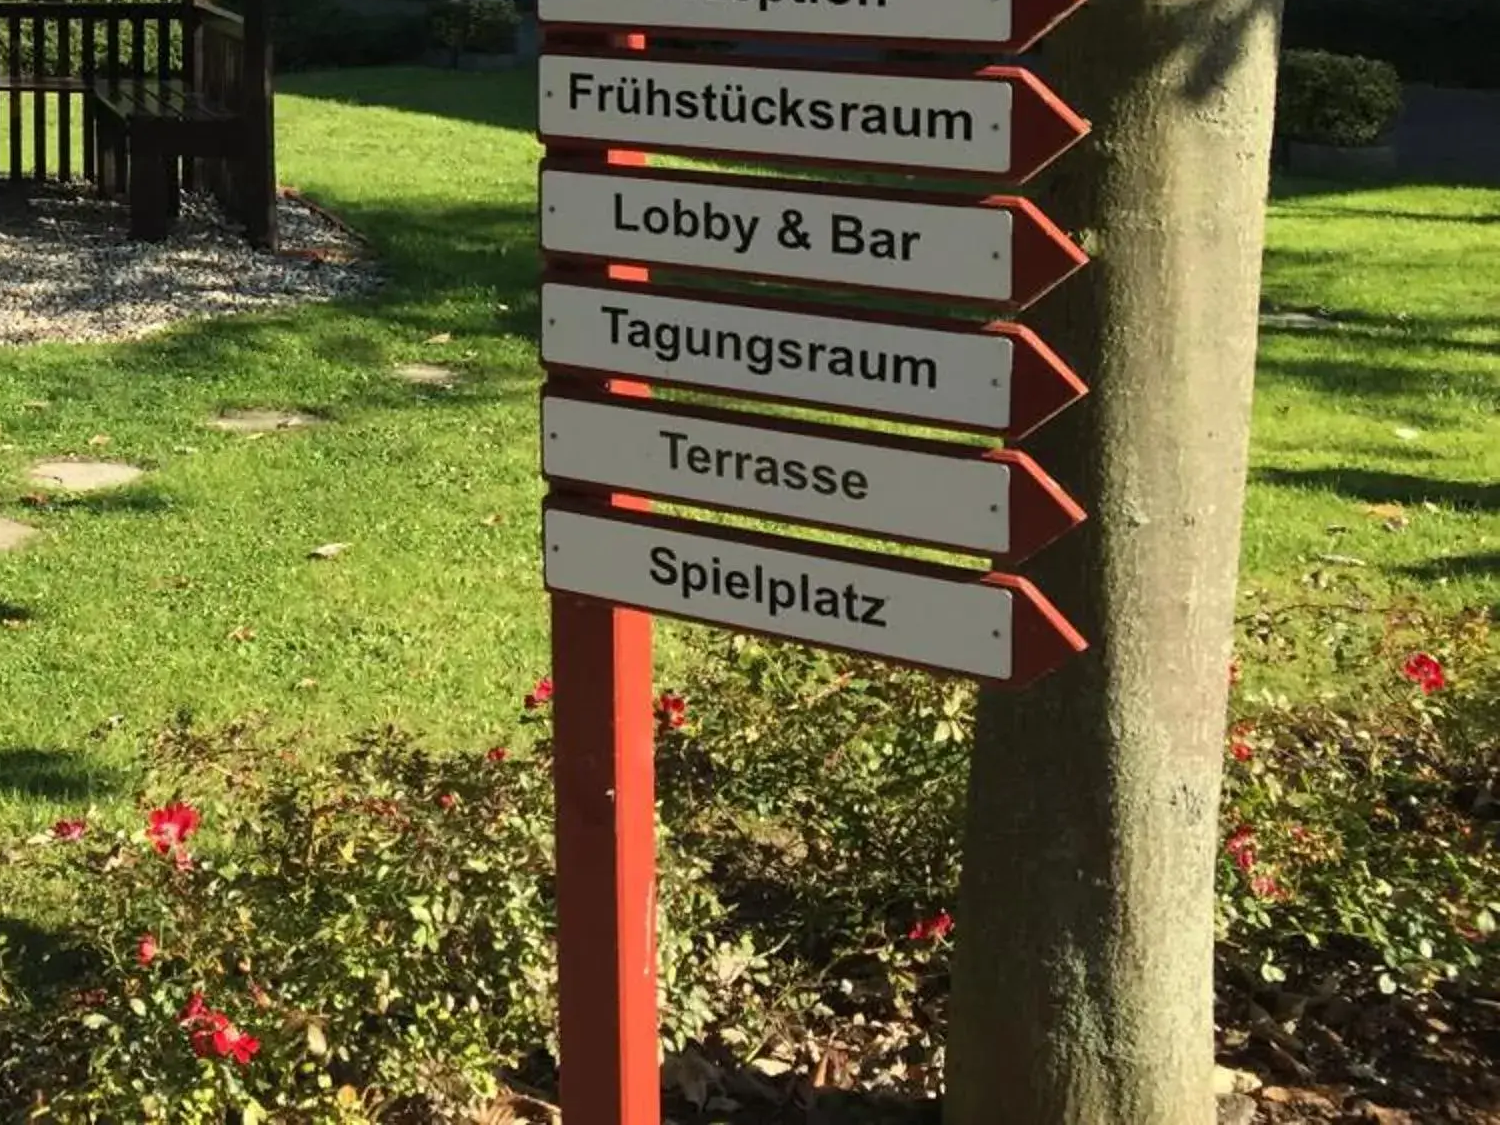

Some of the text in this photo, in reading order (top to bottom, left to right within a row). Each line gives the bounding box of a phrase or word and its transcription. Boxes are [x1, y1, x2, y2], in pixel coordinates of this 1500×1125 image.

[568, 72, 973, 141] Frühstücksraum
[614, 193, 921, 261] Lobby & Bar
[602, 307, 937, 388] Tagungsraum
[659, 431, 869, 500] Terrasse
[649, 547, 888, 628] Spielplatz
